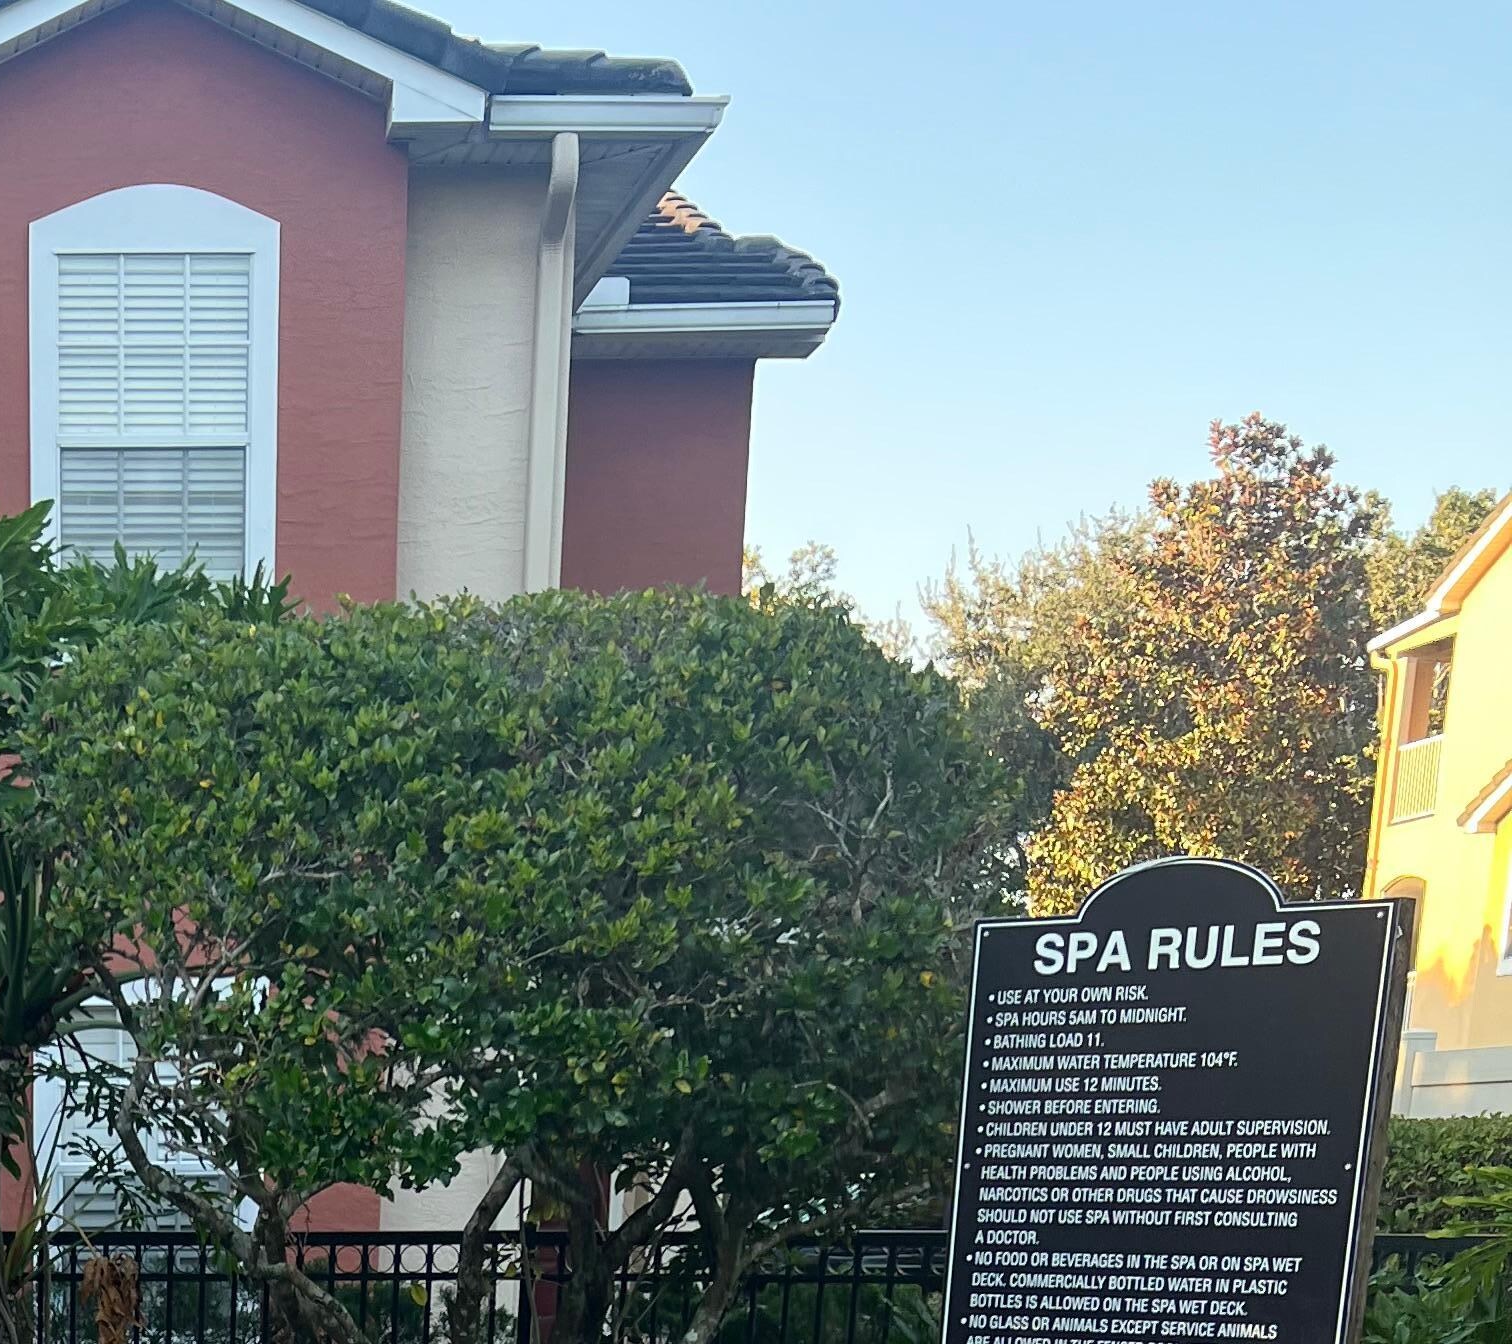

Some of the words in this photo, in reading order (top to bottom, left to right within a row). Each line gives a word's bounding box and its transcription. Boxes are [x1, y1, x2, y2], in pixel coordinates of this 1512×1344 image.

[1033, 930, 1131, 975] SPA
[1147, 920, 1321, 970] RULES
[997, 989, 1023, 1006] USE
[1023, 988, 1041, 1005] AT
[1042, 987, 1079, 1004] YOUR
[1080, 986, 1113, 1003] OWN
[1114, 984, 1149, 1001] RISK.
[994, 1011, 1020, 1028] SPA
[1021, 1010, 1067, 1027] HOURS
[1068, 1009, 1097, 1026] 5AM
[1099, 1008, 1117, 1025] TO
[1119, 1006, 1187, 1024] MIDNIGHT.
[993, 1033, 1047, 1050] BATHING
[1049, 1032, 1084, 1049] LOAD
[1087, 1031, 1105, 1048] 11.
[991, 1055, 1055, 1072] MAXIMUM
[1056, 1054, 1101, 1070] WATER
[1103, 1052, 1198, 1070] TEMPERATURE
[989, 1077, 1053, 1093] MAXIMUM
[1054, 1076, 1081, 1093] USE
[1083, 1077, 1099, 1092] 12
[1100, 1075, 1162, 1092] MINUTES.
[987, 1099, 1042, 1115] SHOWER
[1043, 1099, 1093, 1115] BEFORE
[1093, 1098, 1161, 1115] ENTERING.
[985, 1121, 1048, 1137] CHILDREN
[1049, 1121, 1094, 1137] UNDER
[1096, 1121, 1112, 1137] 12
[1114, 1120, 1153, 1137] MUST
[1154, 1120, 1189, 1136] HAVE
[1190, 1120, 1235, 1137] ADULT
[1236, 1119, 1331, 1136] SUPERVISION.
[983, 1143, 1051, 1159] PREGNANT
[1052, 1143, 1105, 1160] WOMEN,
[1107, 1143, 1151, 1159] SMALL
[1153, 1143, 1223, 1161] CHILDREN,
[1226, 1142, 1279, 1159] PEOPLE
[1280, 1142, 1317, 1159] WITH
[980, 1165, 1028, 1180] HEALTH
[1029, 1165, 1098, 1181] PROBLEMS
[1099, 1165, 1128, 1181] AND
[1129, 1165, 1180, 1181] PEOPLE
[1181, 1165, 1224, 1182] USING
[1225, 1165, 1292, 1184] ALCOHOL,
[978, 1186, 1049, 1202] NARCOTICS
[1050, 1187, 1070, 1202] OR
[1071, 1187, 1115, 1203] OTHER
[1116, 1187, 1163, 1204] DRUGS
[1164, 1188, 1199, 1204] THAT
[1199, 1188, 1245, 1204] CAUSE
[1246, 1188, 1338, 1205] DROWSINESS
[976, 1208, 1028, 1224] SHOULD
[1029, 1208, 1057, 1224] NOT
[1057, 1209, 1084, 1225] USE
[1084, 1209, 1111, 1225] SPA
[1112, 1209, 1173, 1226] WITHOUT
[1173, 1210, 1213, 1226] FIRST
[1213, 1210, 1298, 1228] CONSULTING
[974, 1229, 985, 1244] A
[986, 1229, 1040, 1246] DOCTOR.
[974, 1250, 993, 1266] NO
[994, 1251, 1029, 1266] FOOD
[1030, 1251, 1049, 1267] OR
[1051, 1252, 1124, 1269] BEVERAGES
[1126, 1254, 1141, 1269] IN
[1143, 1254, 1169, 1270] THE
[1170, 1254, 1196, 1270] SPA
[1198, 1255, 1219, 1271] OR
[1220, 1255, 1241, 1272] ON
[1243, 1256, 1270, 1272] SPA
[1272, 1257, 1303, 1273] WET
[971, 1272, 1007, 1288] DECK.
[1009, 1272, 1107, 1290] COMMERCIALLY
[1107, 1275, 1165, 1292] BOTTLED
[1167, 1276, 1213, 1293] WATER
[1214, 1278, 1231, 1294] IN
[1232, 1278, 1289, 1296] PLASTIC
[969, 1293, 1023, 1309] BOTTLES
[1025, 1294, 1038, 1310] IS
[1039, 1295, 1101, 1312] ALLOWED
[1102, 1296, 1122, 1312] ON
[1124, 1297, 1150, 1313] THE
[1150, 1298, 1177, 1314] SPA
[1178, 1299, 1209, 1315] WET
[1209, 1300, 1248, 1316] DECK.
[968, 1314, 988, 1329] NO
[989, 1314, 1030, 1331] GLASS
[1031, 1316, 1051, 1331] OR
[1051, 1317, 1109, 1334] ANIMALS
[1110, 1319, 1160, 1335] EXCEPT
[1160, 1320, 1216, 1338] SERVICE
[1216, 1322, 1278, 1340] ANIMALS
